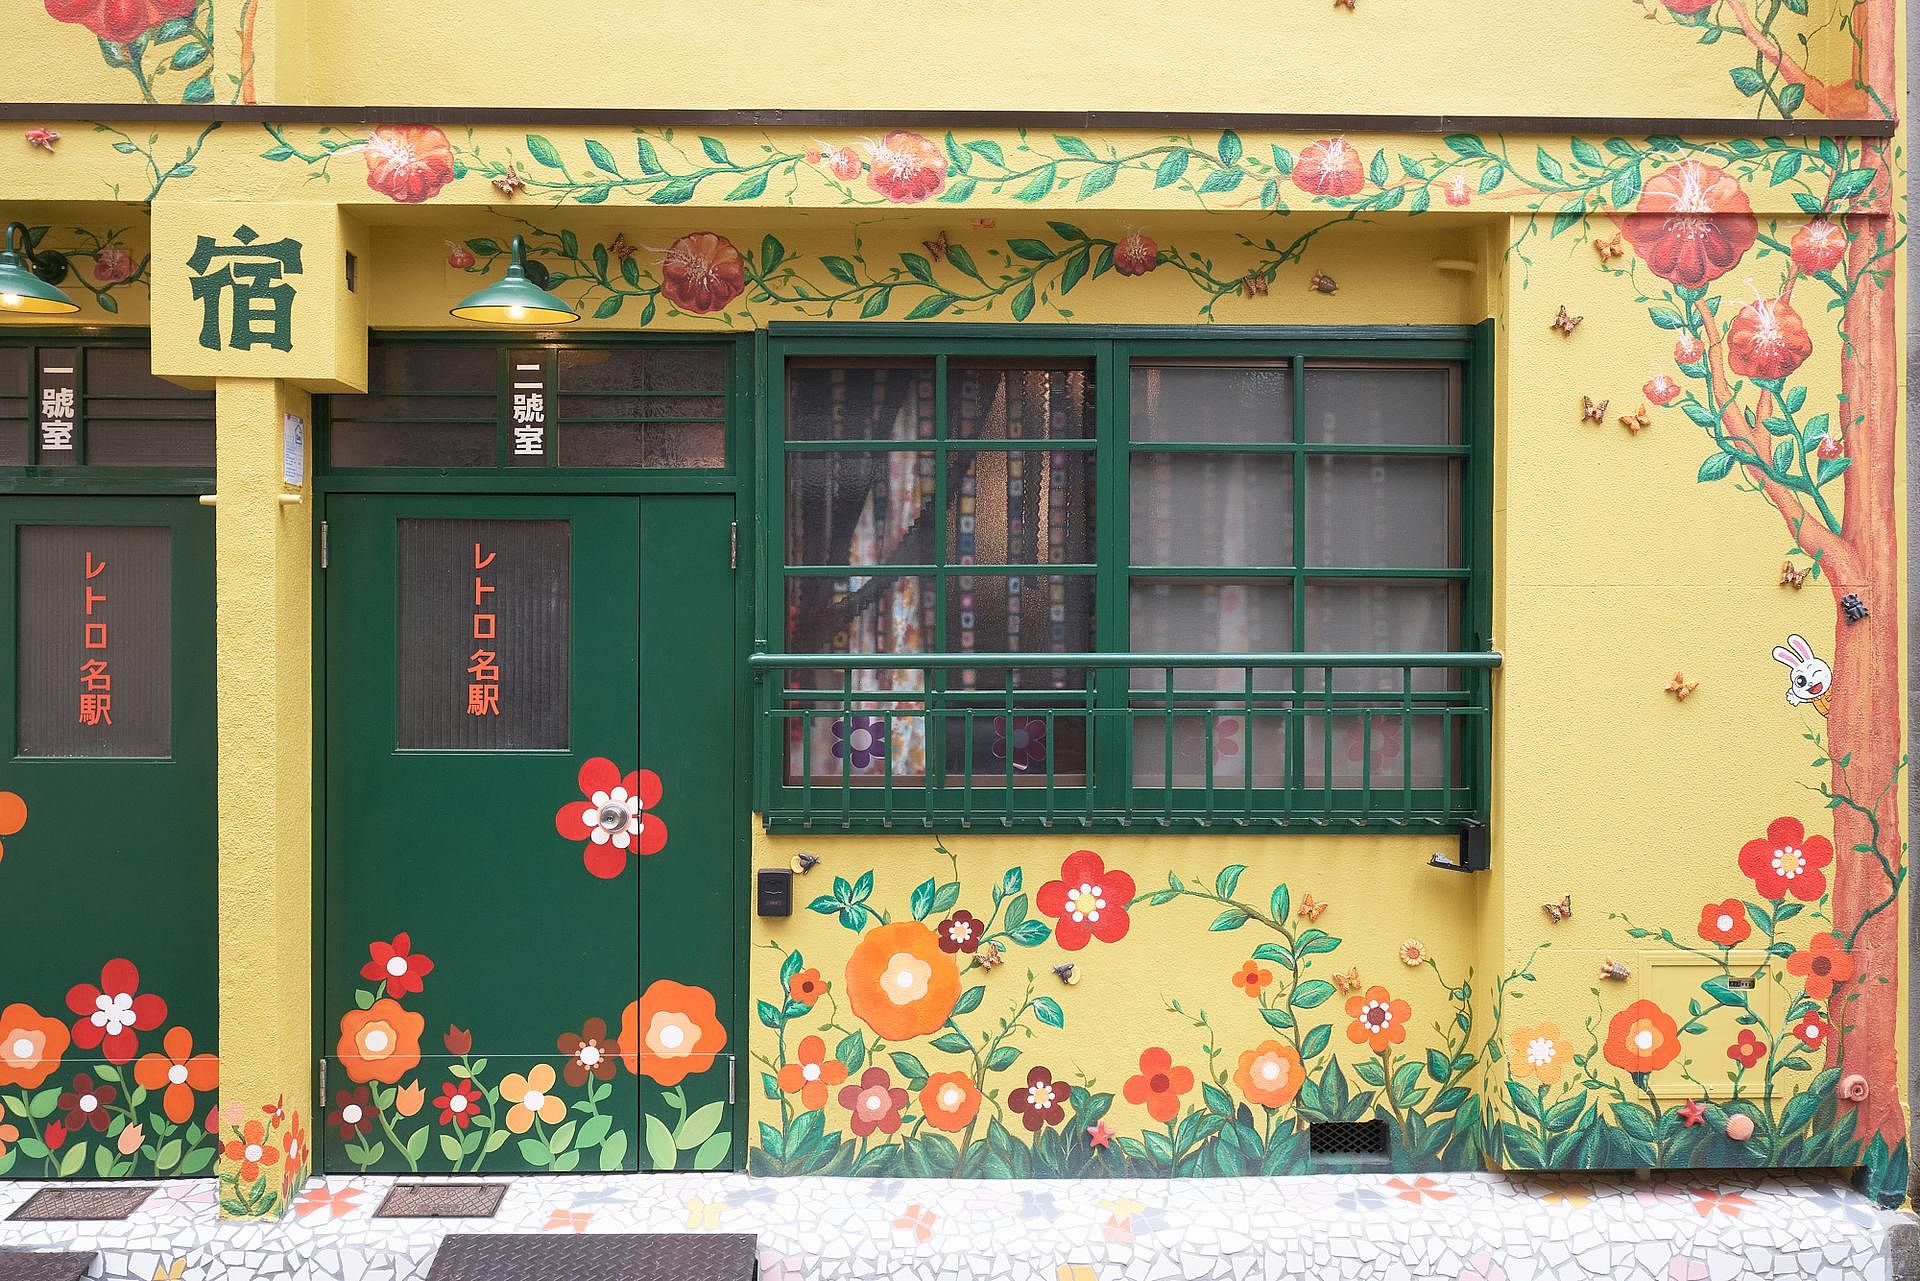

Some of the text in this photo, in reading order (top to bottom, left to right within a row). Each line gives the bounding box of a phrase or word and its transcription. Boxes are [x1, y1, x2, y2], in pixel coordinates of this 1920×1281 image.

[186, 225, 303, 352] 宿
[41, 366, 74, 450] 一號室
[513, 363, 545, 455] 二號室
[79, 551, 112, 726] レトロ名駅
[467, 543, 500, 716] レトロ名駅
